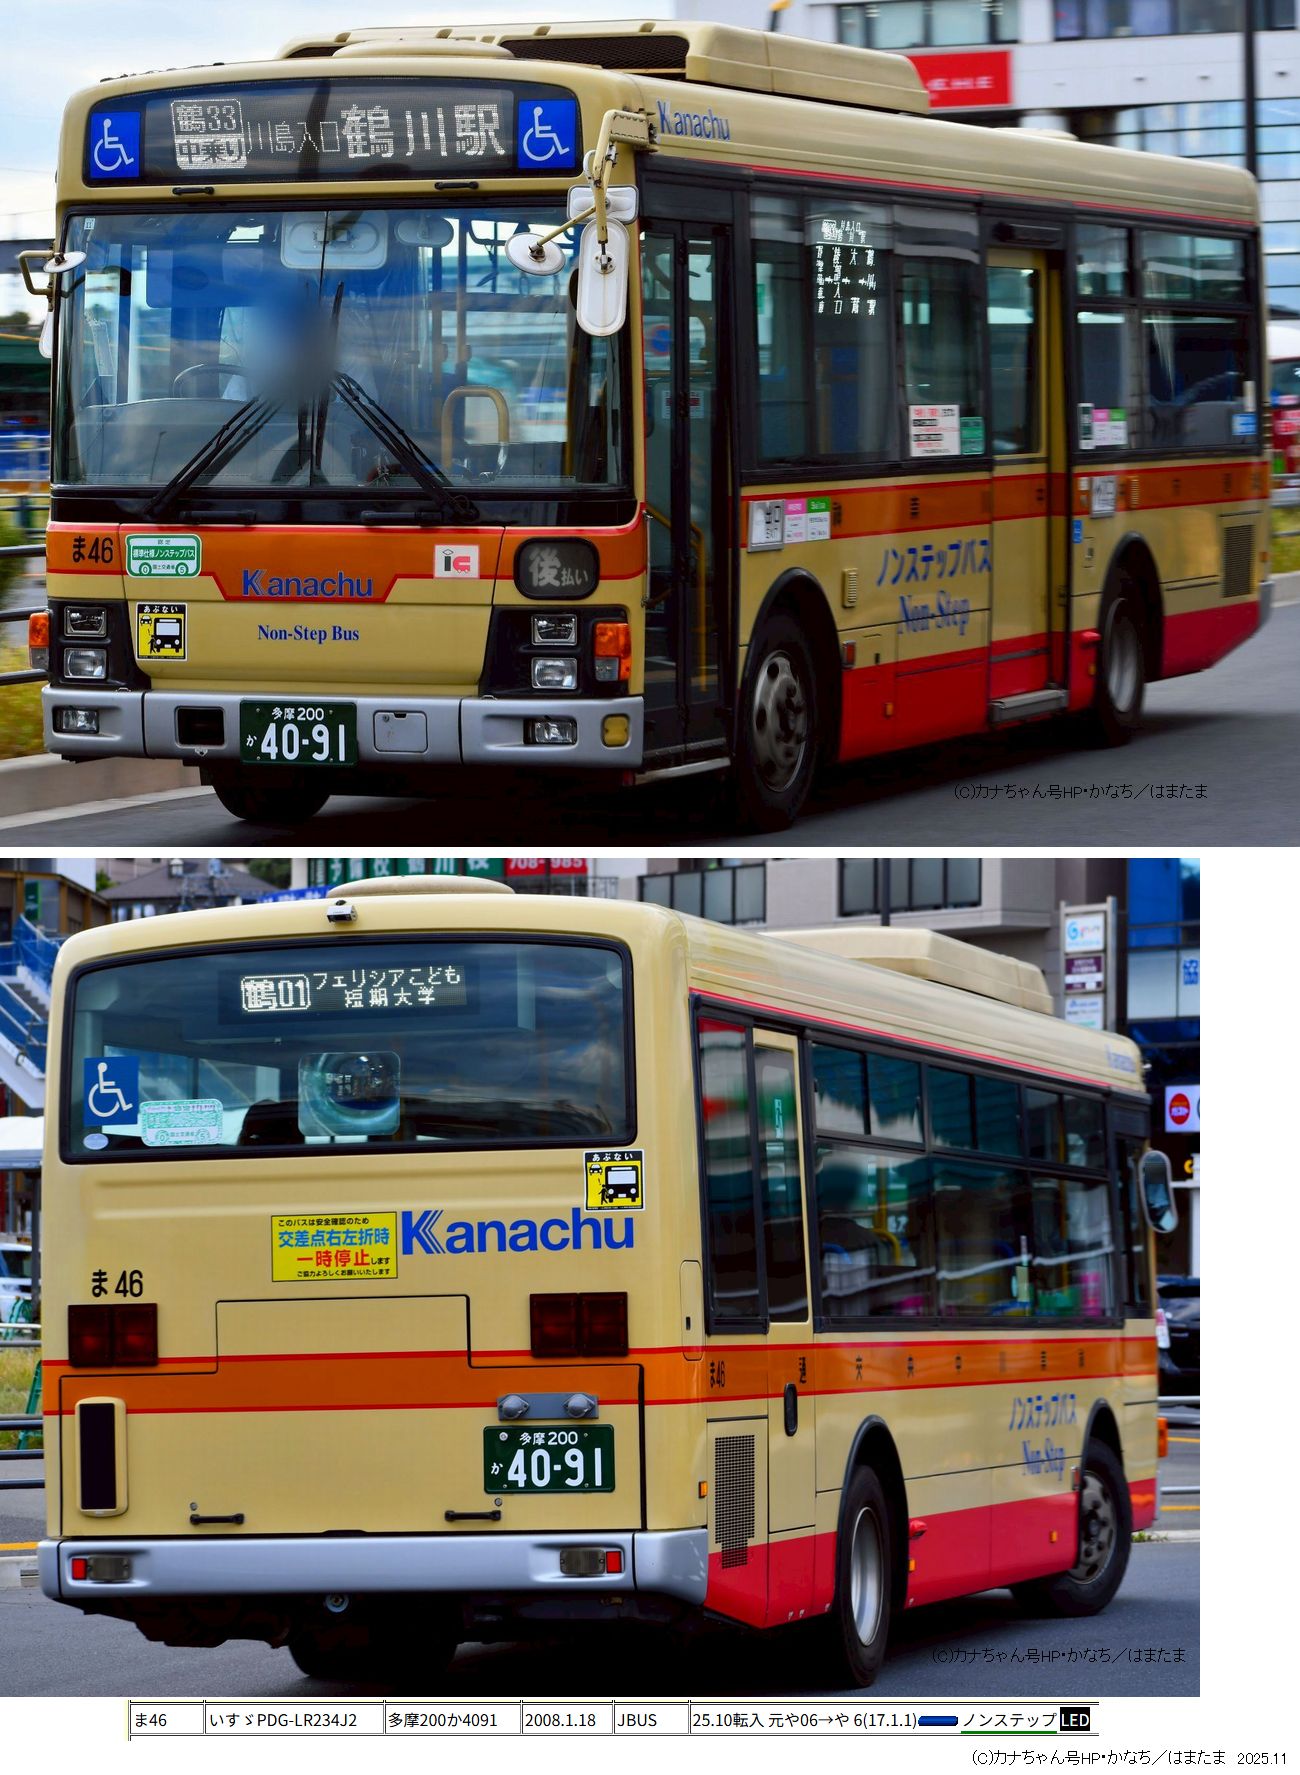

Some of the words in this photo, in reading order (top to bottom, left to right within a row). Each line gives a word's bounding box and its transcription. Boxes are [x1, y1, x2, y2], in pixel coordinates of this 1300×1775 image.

[176, 105, 237, 132] 鶴33
[657, 100, 730, 140] Kanachu
[247, 120, 340, 153] 川島入口
[341, 104, 505, 158] 鶴川駅
[178, 139, 243, 163] 中乗り
[73, 536, 113, 563] ま46
[877, 540, 992, 586] ノンステップバス
[242, 569, 373, 597] Kanachu
[143, 605, 179, 613] あぶない
[258, 624, 327, 644] Non-Step
[332, 625, 359, 641] Bus
[272, 707, 325, 721] 多摩200
[246, 735, 257, 747] か
[261, 723, 346, 762] 40-91
[313, 966, 461, 990] フェリシアこども
[245, 980, 306, 1010] 鶴01
[345, 987, 435, 1009] 短期大学
[592, 1153, 633, 1162] あぶない
[278, 1217, 369, 1227] このバスは安全確認のため
[401, 1208, 634, 1256] Kanachu
[278, 1227, 390, 1248] 交差点右左折時
[297, 1249, 390, 1267] 一時停止します
[297, 1268, 390, 1277] ご協力よろしくお願いいたします
[1009, 1393, 1077, 1431] ノンステップバス
[520, 1432, 578, 1445] 多摩200
[491, 1462, 503, 1475] か
[508, 1448, 602, 1487] 40-91
